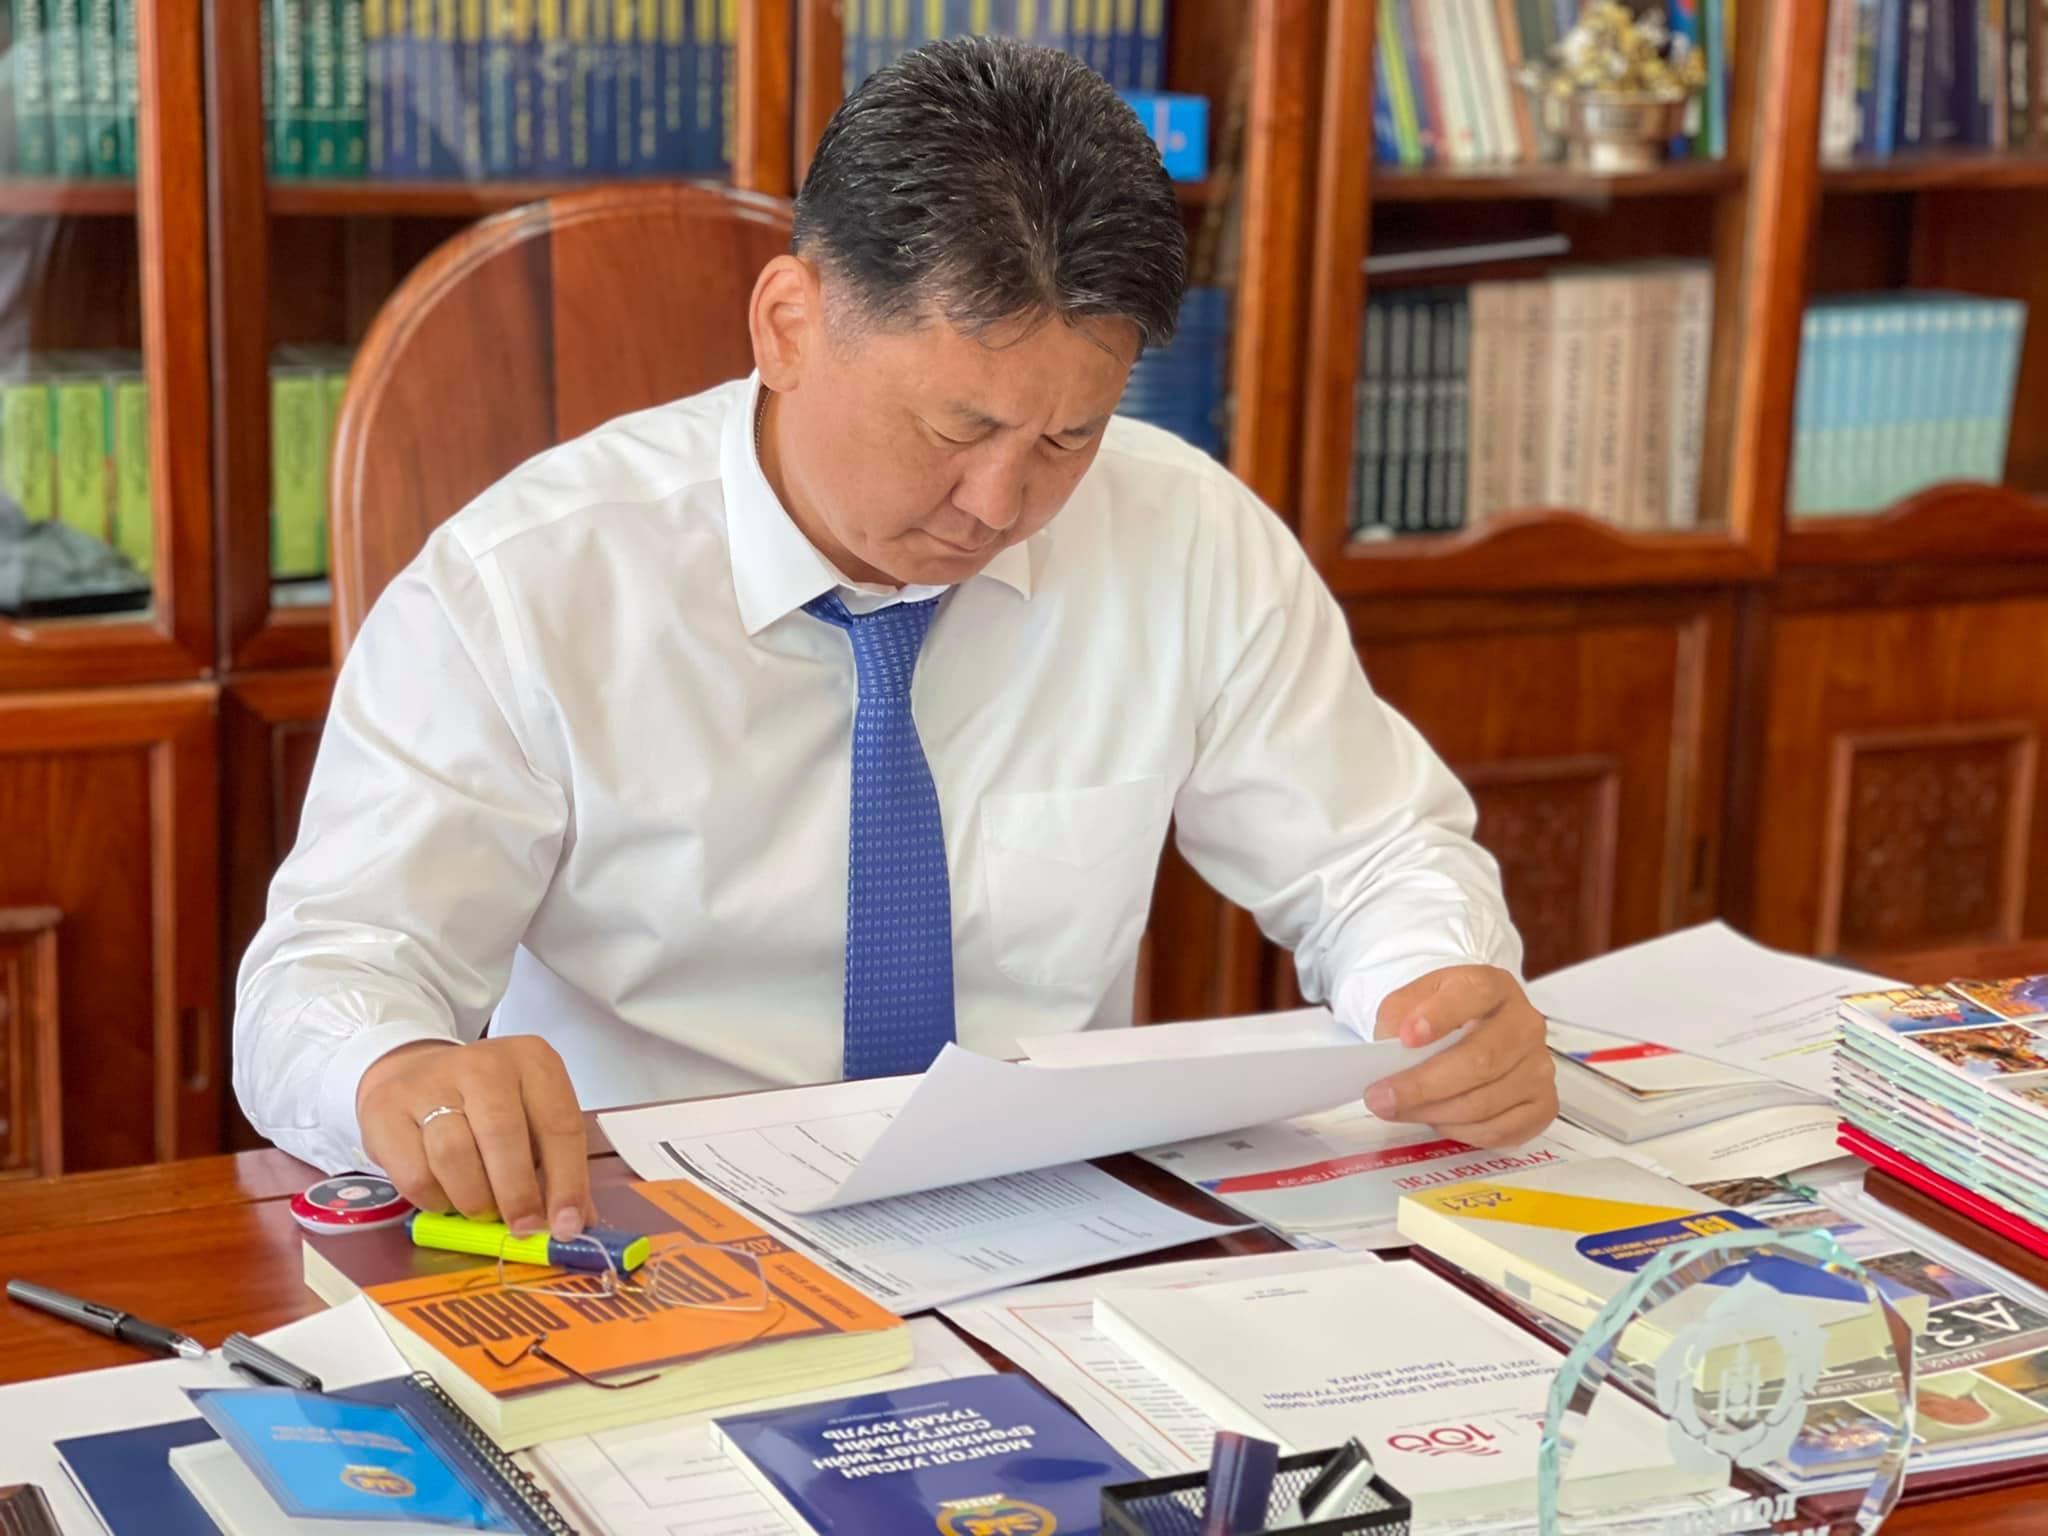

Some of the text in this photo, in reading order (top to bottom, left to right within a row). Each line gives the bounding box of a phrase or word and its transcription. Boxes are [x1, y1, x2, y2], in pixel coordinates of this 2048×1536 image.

[1442, 1192, 1513, 1212] 2021
[407, 1288, 569, 1349] ОНОЛ
[1325, 1358, 1455, 1385] ГАРЫН АВЛАГА
[1455, 1363, 1496, 1378] ОНЫ
[821, 1419, 897, 1441] ХУУЛЬ
[902, 1406, 981, 1431] ТУХАЙ
[812, 1423, 1035, 1470] ЕРӨНХИЙЛӨГЧИЙН
[833, 1418, 992, 1453] СОНГУУЛИЙН
[1386, 1424, 1496, 1452] 100
[841, 1436, 1033, 1480] МОНГОЛ УЛСЫН
